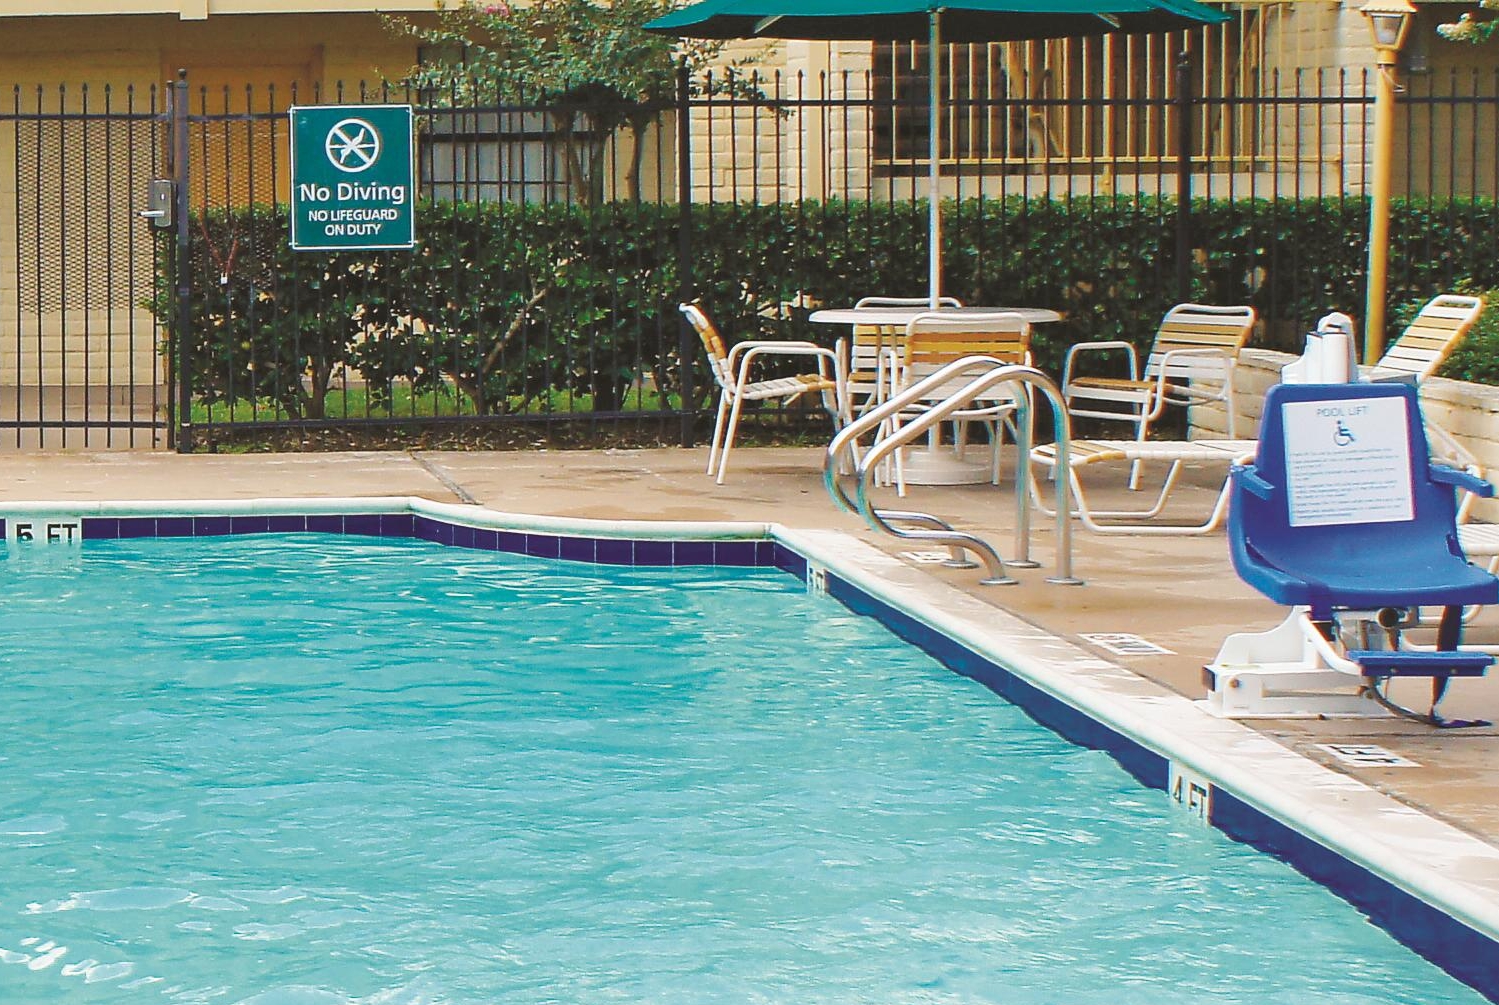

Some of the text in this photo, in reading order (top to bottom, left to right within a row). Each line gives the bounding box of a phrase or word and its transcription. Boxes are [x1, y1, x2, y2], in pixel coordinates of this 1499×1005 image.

[300, 181, 404, 205] No Diving
[308, 208, 398, 221] NO LIFEGUARD
[324, 223, 381, 236] ON DUTY
[1316, 405, 1369, 417] POOL LIFT
[16, 523, 78, 544] 5 FT
